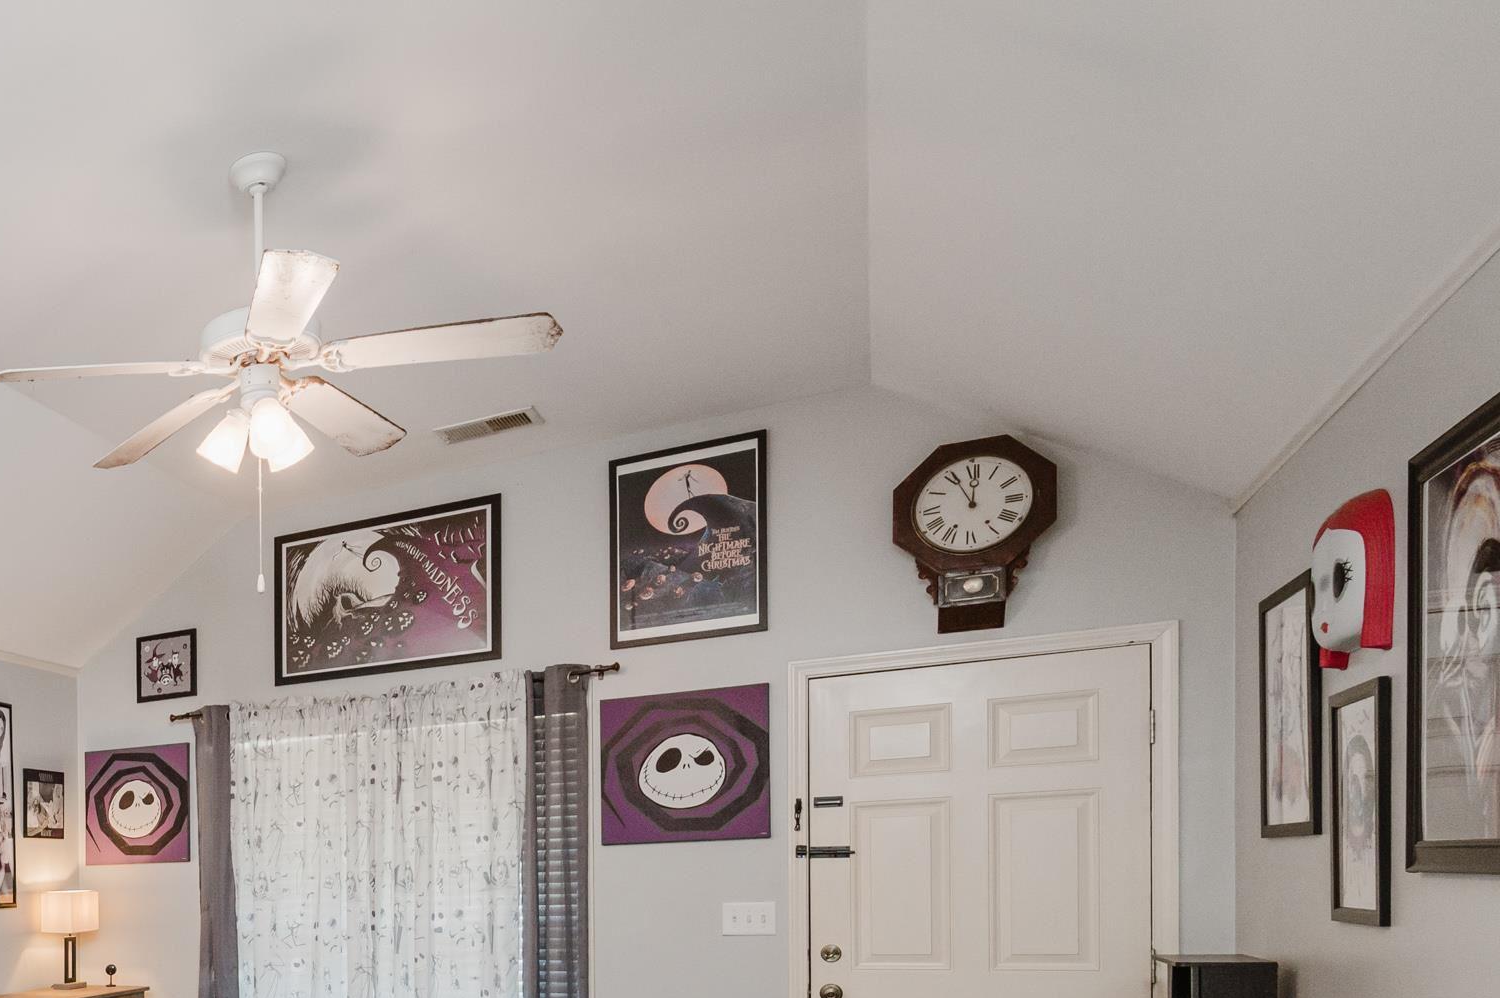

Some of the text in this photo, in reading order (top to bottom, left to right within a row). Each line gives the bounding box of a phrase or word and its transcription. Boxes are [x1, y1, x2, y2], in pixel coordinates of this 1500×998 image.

[698, 538, 753, 557] NIGHTMARE
[711, 548, 743, 561] BEFORE
[701, 556, 751, 572] CHRISTMAS
[422, 560, 478, 629] MADNESS
